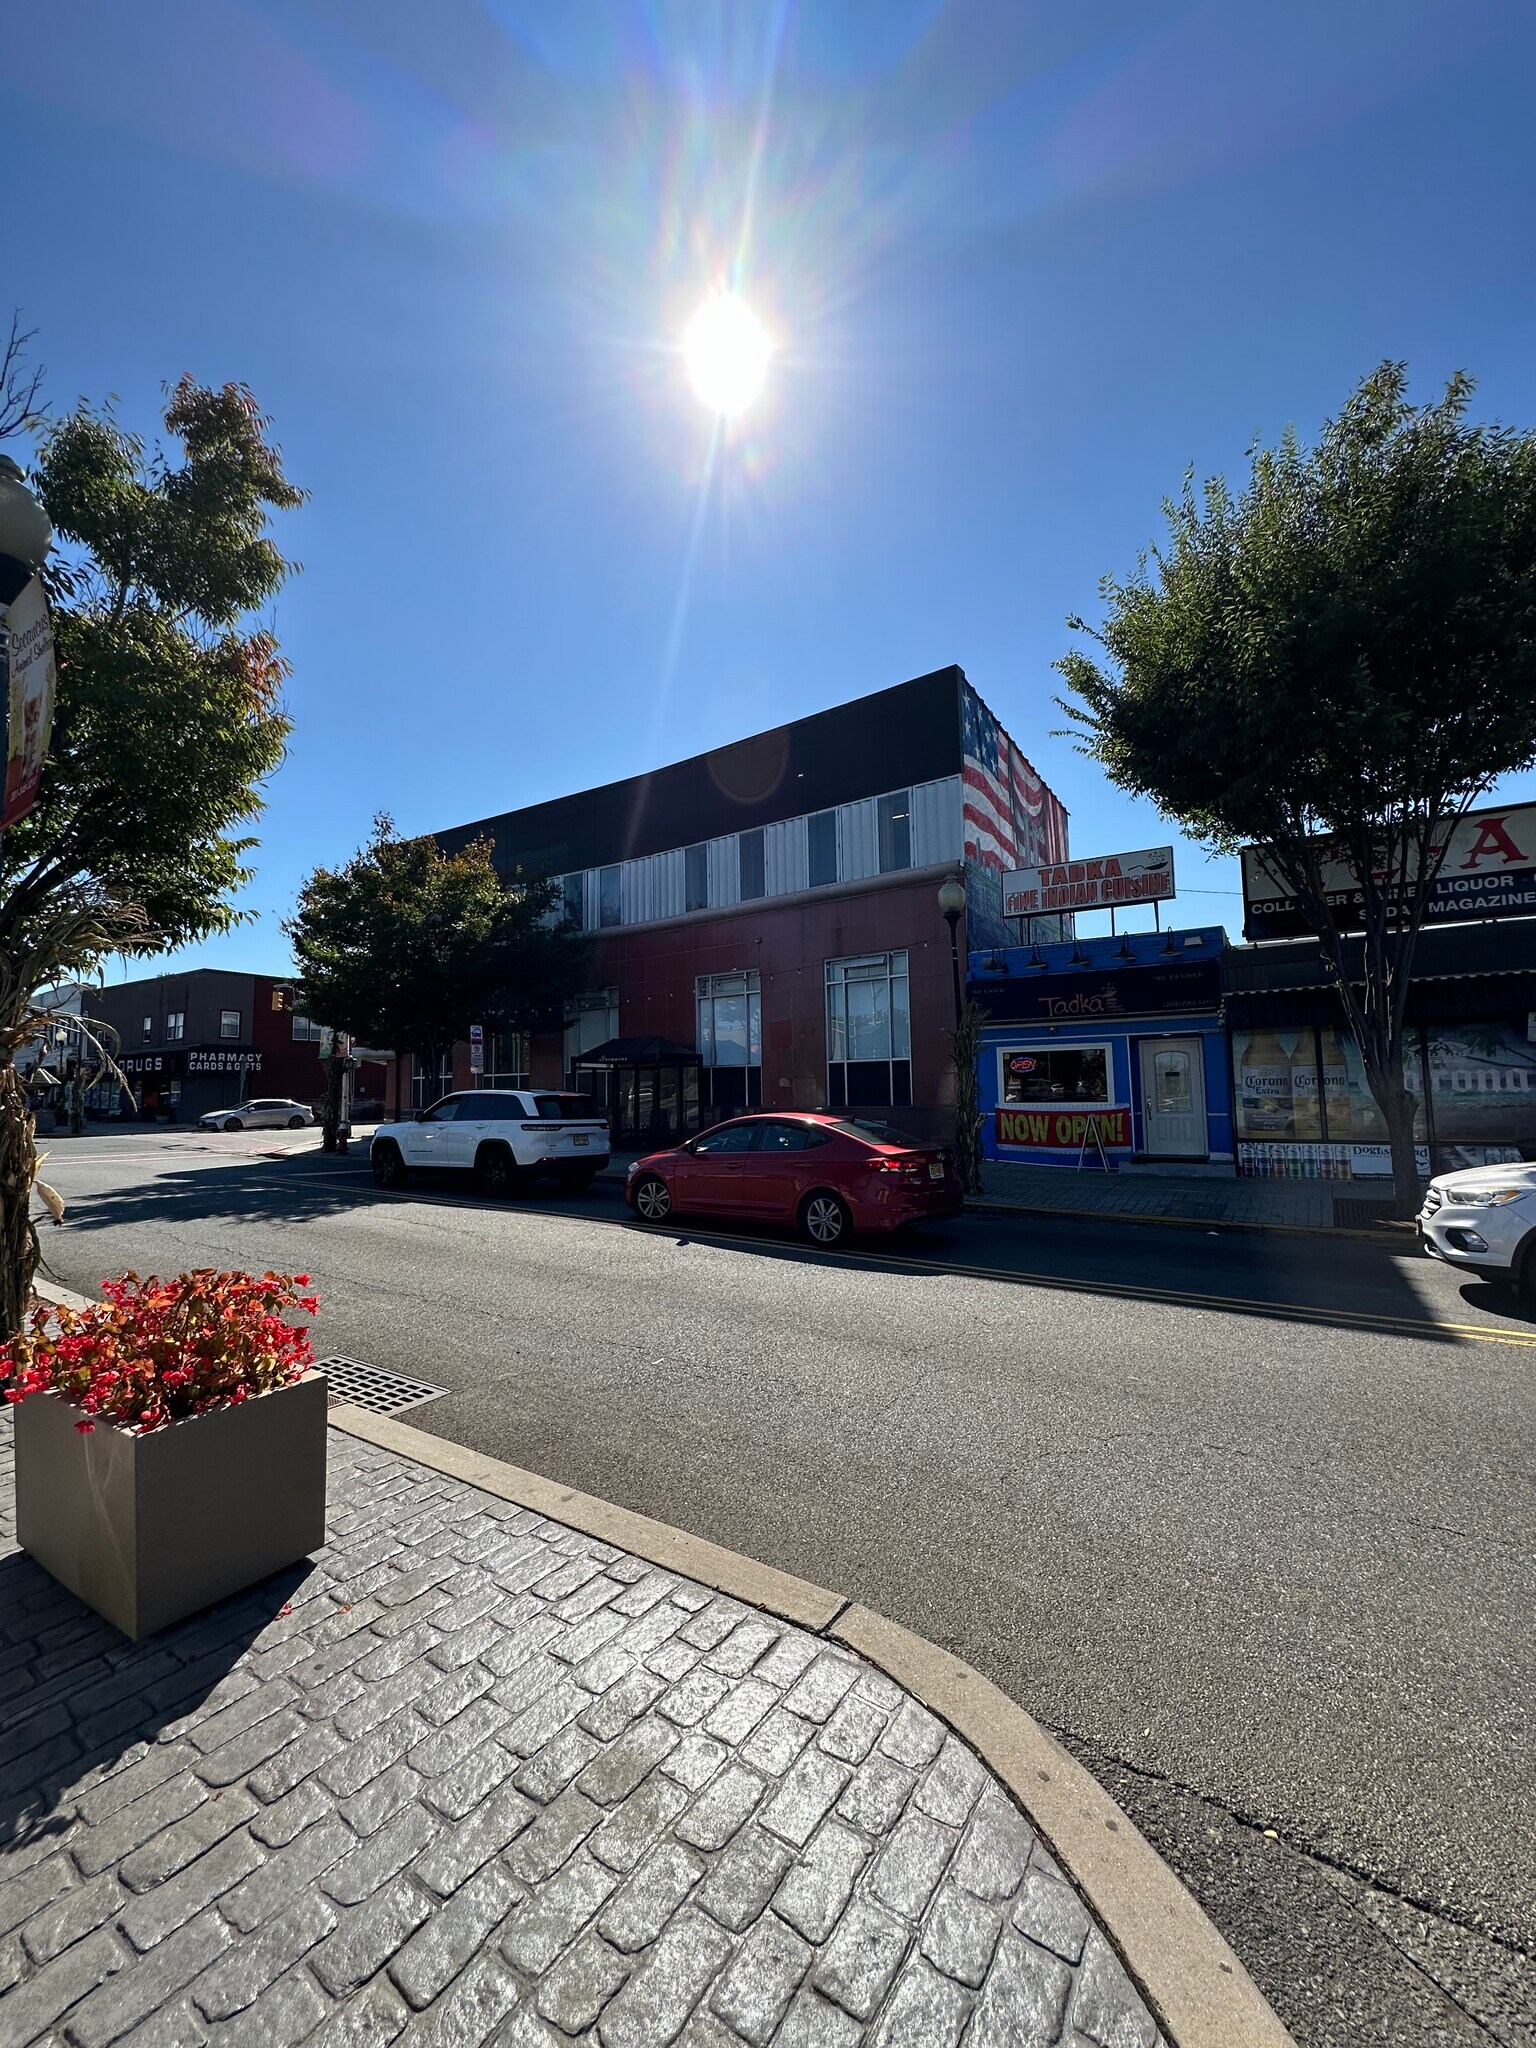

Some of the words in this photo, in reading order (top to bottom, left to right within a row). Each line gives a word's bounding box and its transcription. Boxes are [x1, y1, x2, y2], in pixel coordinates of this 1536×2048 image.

[1038, 858, 1122, 887] TADKA
[1005, 889, 1038, 914] FINE
[1041, 881, 1098, 910] INDIAN
[1101, 871, 1171, 902] CUISINE
[1436, 875, 1515, 894] LIQUOR
[1359, 904, 1412, 921] SDA
[1038, 993, 1105, 1017] Tadka
[118, 1057, 163, 1073] DRUGS
[190, 1052, 263, 1062] PHARMACY
[1010, 1060, 1037, 1070] OPEN
[189, 1061, 224, 1071] CARDS
[225, 1061, 233, 1071] &
[1245, 1074, 1288, 1089] Corona
[1255, 1086, 1280, 1095] Extra
[1000, 1112, 1050, 1143] NOW
